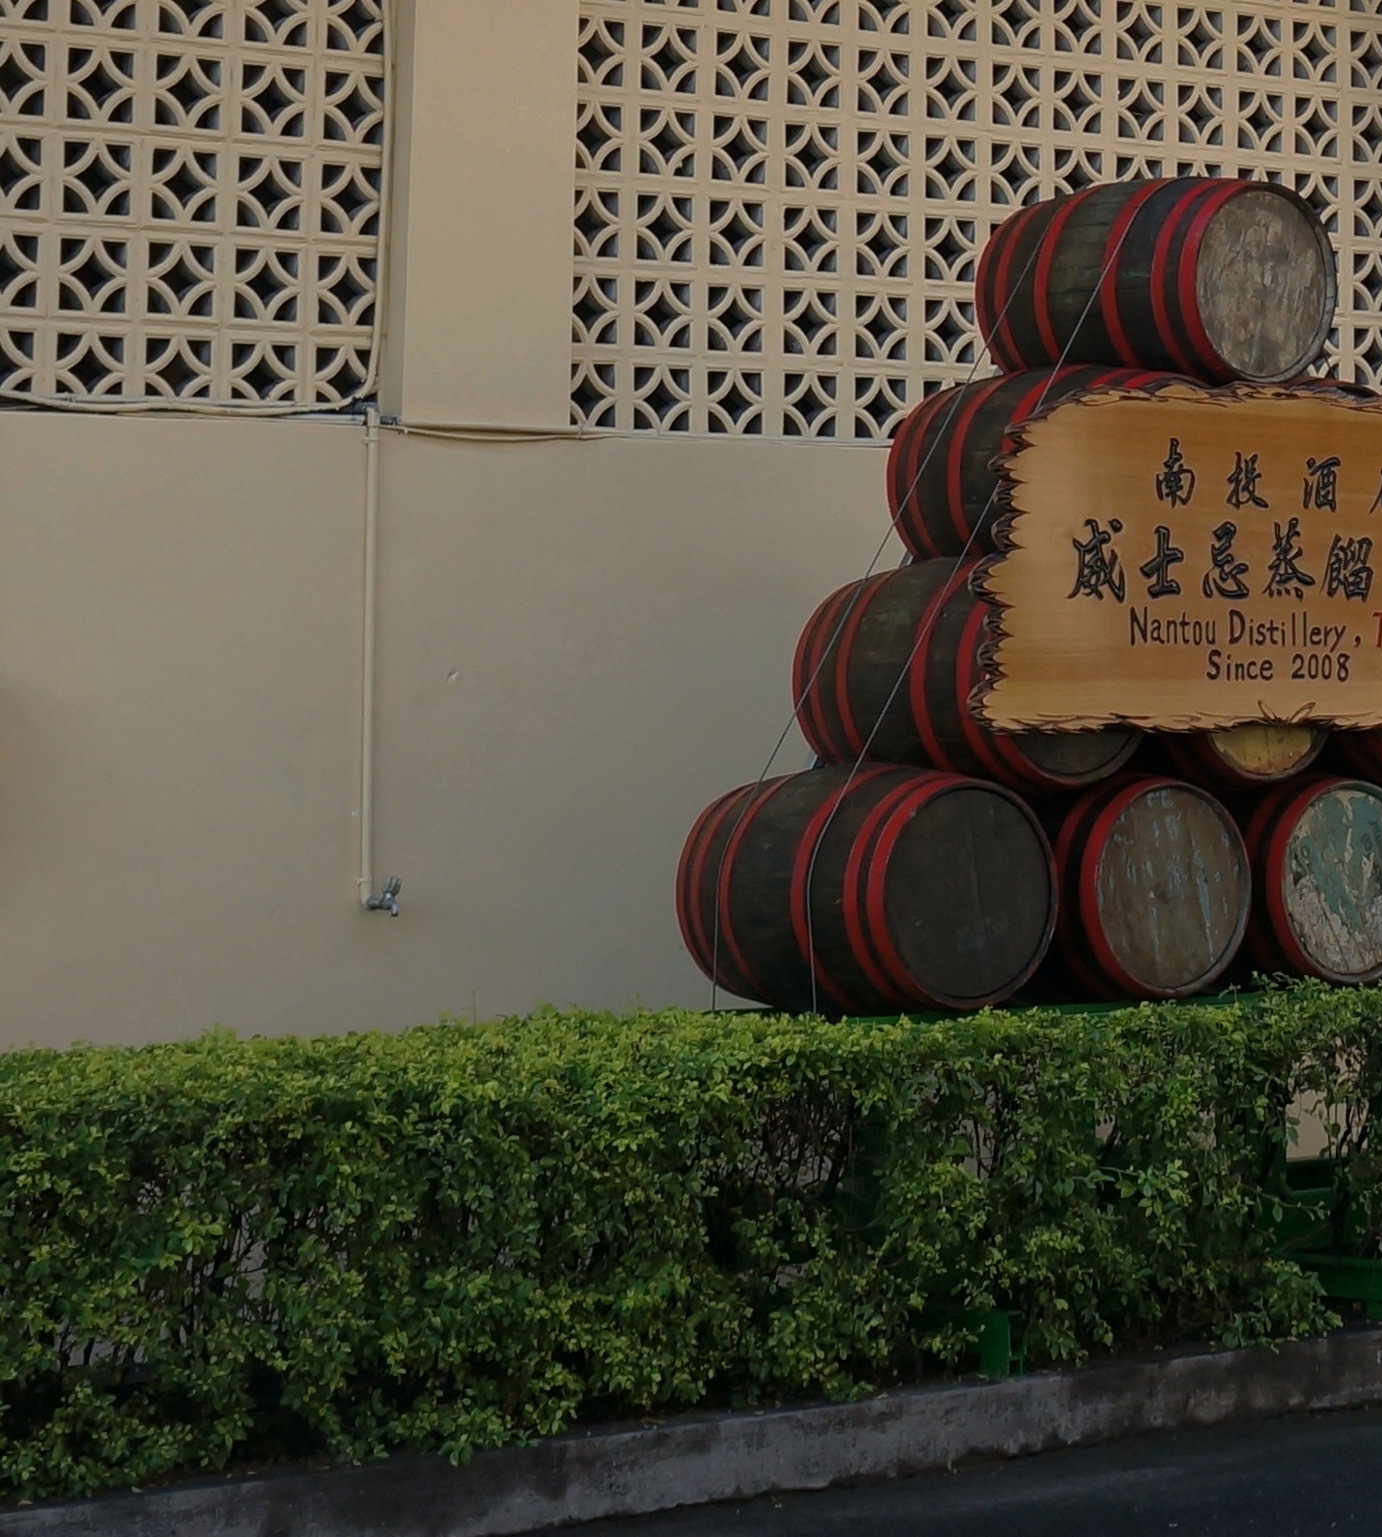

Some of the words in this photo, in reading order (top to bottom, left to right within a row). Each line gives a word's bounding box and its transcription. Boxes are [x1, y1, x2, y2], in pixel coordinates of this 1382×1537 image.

[1129, 606, 1217, 647] Nantou
[1228, 609, 1362, 653] Distillery,
[1206, 649, 1274, 682] Since
[1291, 652, 1351, 682] 2008
